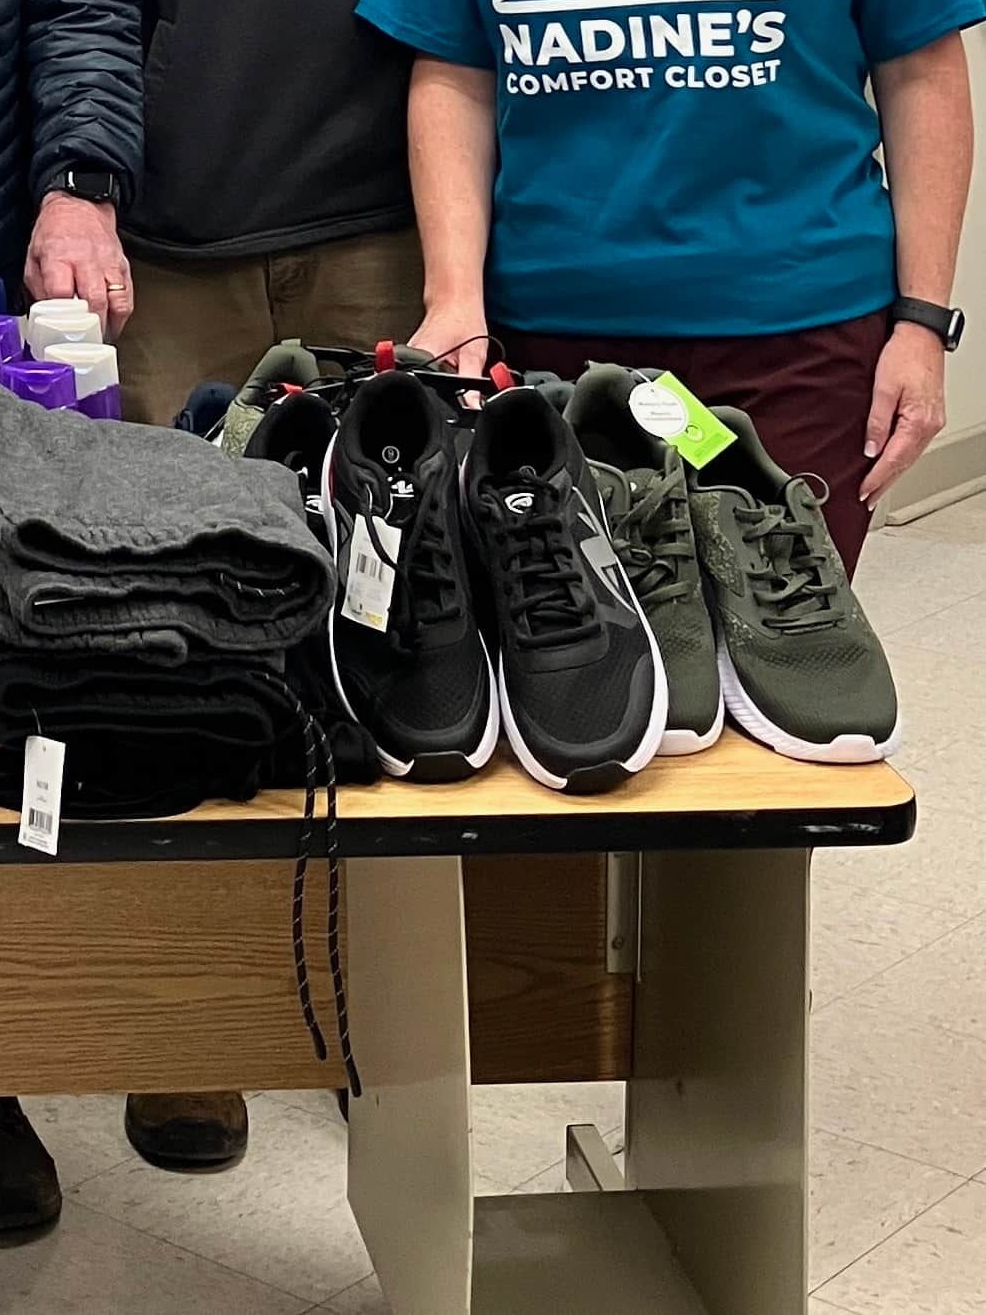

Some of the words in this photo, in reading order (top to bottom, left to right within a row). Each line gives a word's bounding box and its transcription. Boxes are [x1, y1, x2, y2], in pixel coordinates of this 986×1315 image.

[499, 9, 786, 66] NADINE'S
[506, 67, 654, 95] COMFORT
[664, 59, 782, 89] CLOSET
